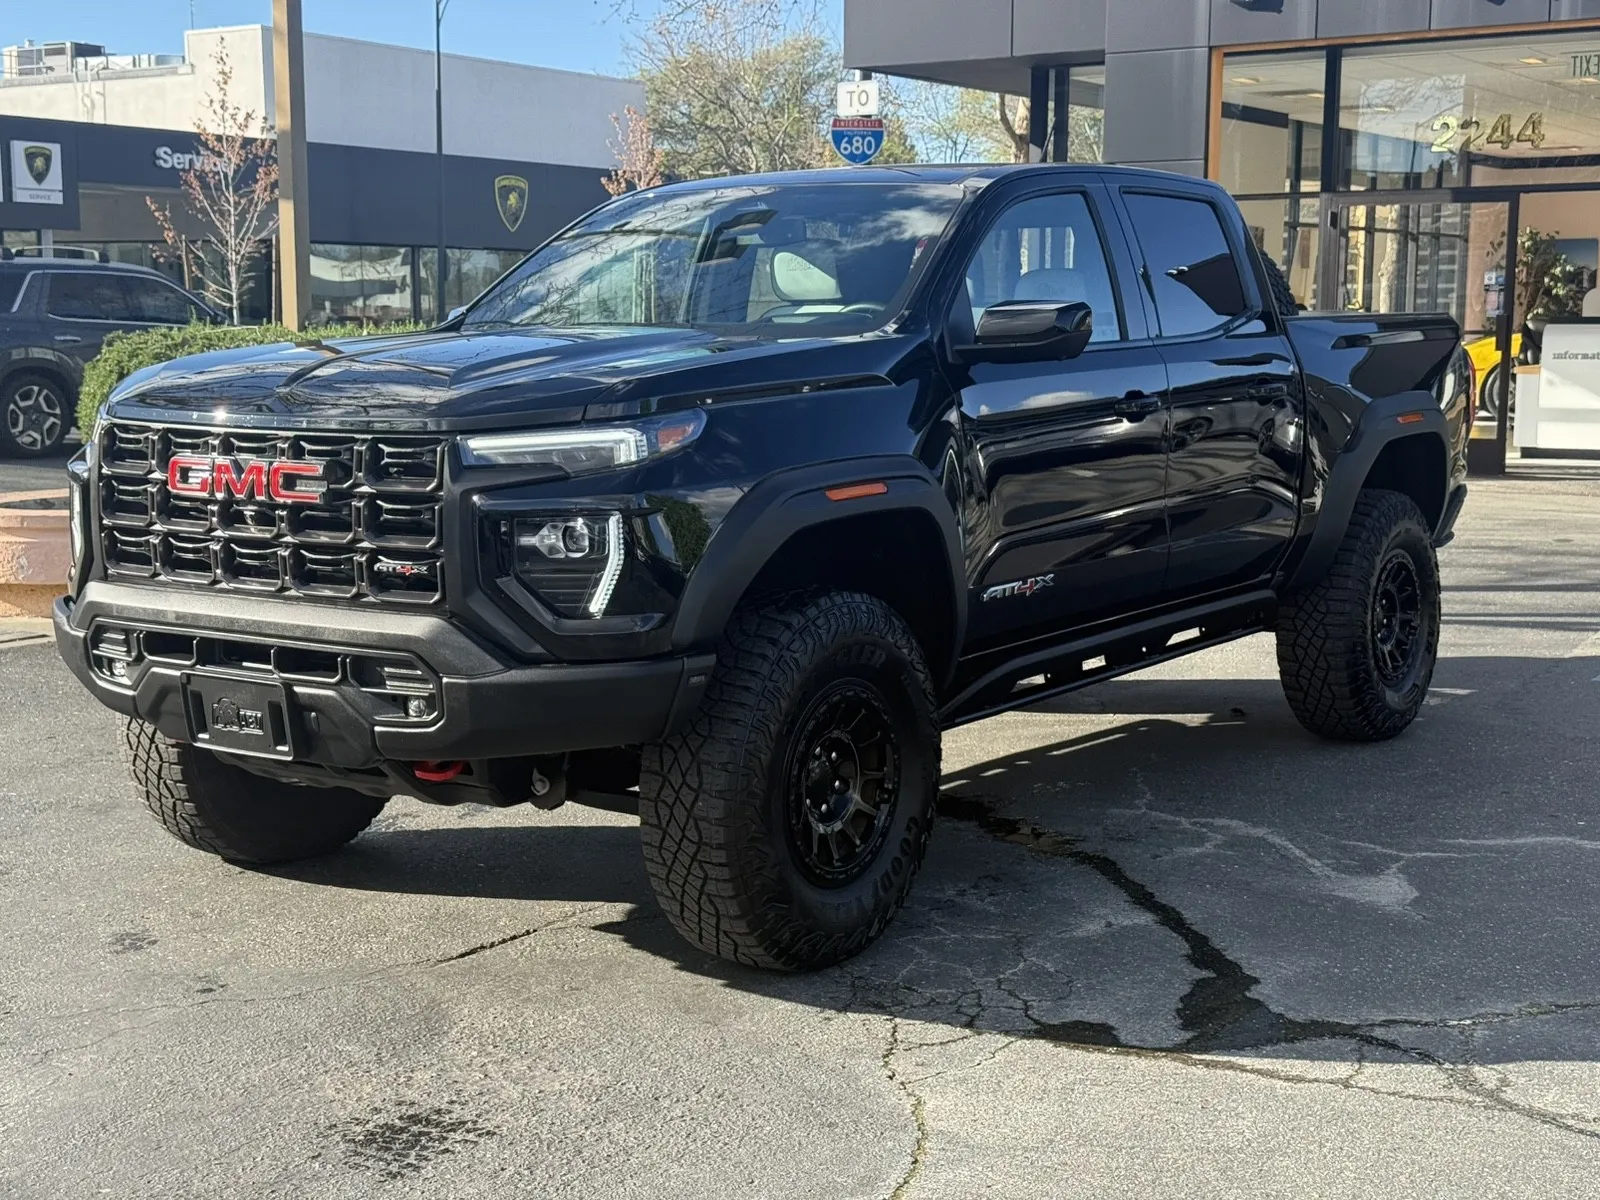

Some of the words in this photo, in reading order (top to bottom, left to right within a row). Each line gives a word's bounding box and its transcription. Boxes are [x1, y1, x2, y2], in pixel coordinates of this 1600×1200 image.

[846, 89, 869, 107] TO
[836, 120, 880, 128] INTERSTATE
[1430, 111, 1546, 153] 2244
[840, 136, 876, 155] 680
[168, 456, 328, 504] GMC
[980, 573, 1056, 602] AT4X
